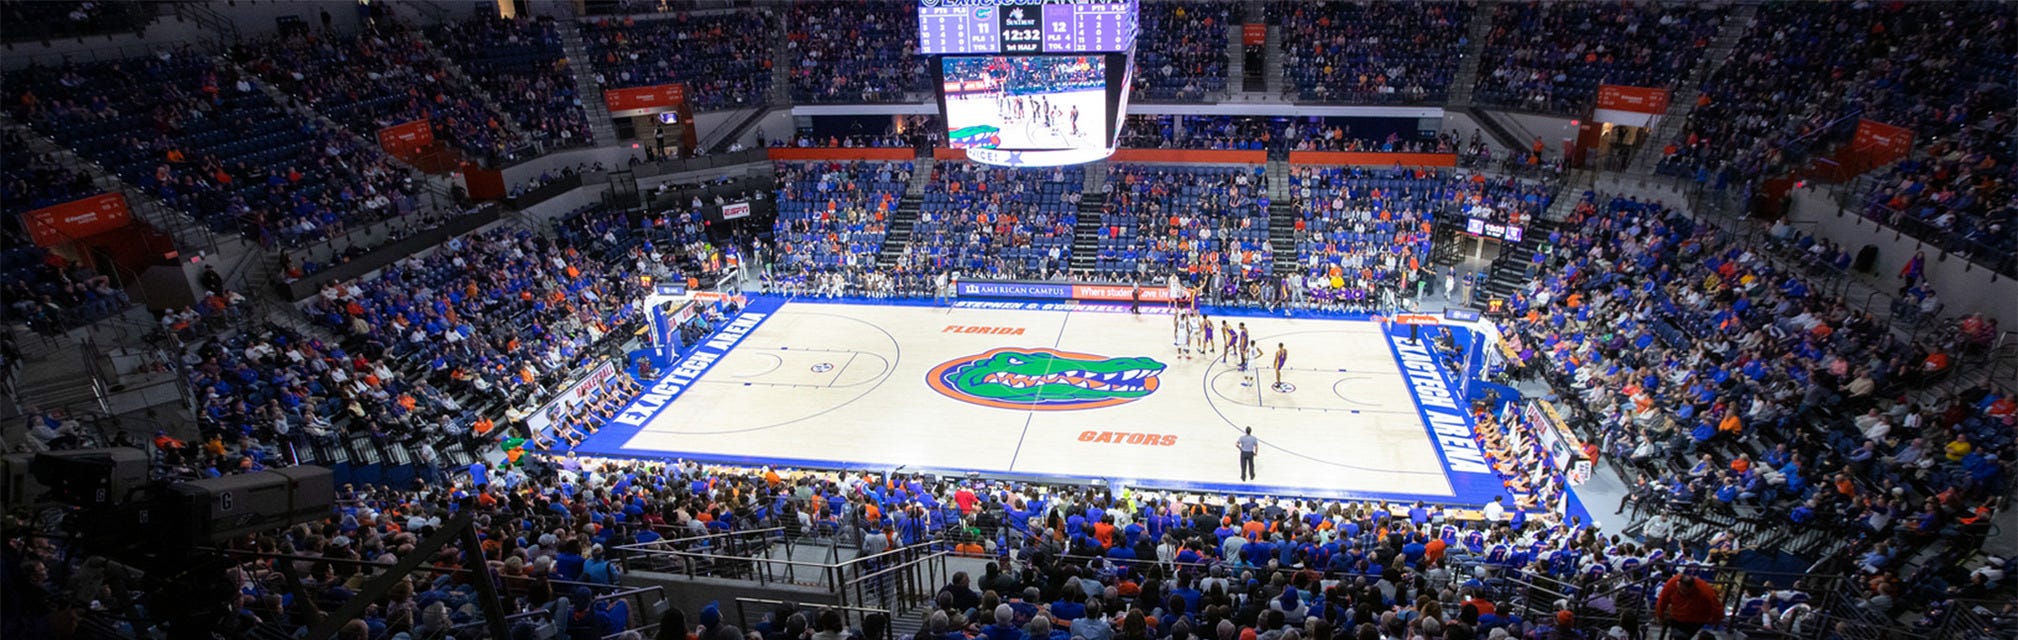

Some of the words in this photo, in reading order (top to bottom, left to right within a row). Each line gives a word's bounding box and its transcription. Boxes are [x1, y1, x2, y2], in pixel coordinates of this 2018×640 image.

[977, 23, 989, 34] 11
[1052, 21, 1067, 32] 12
[1002, 29, 1041, 41] 12:32
[725, 206, 749, 216] ESPN
[981, 286, 1027, 295] AMERICAN
[1028, 287, 1064, 296] CAMPUS
[1081, 287, 1105, 296] Where
[955, 301, 1023, 310] STEPHEN
[942, 325, 1026, 335] FLORIDA
[612, 350, 721, 426] EXACTECH
[705, 312, 767, 351] ARENA
[576, 364, 614, 399] BASKETBALL
[1391, 335, 1458, 410] EXACTECH
[1425, 408, 1492, 474] ARENA
[1077, 430, 1178, 446] GATORS
[222, 493, 232, 510] G
